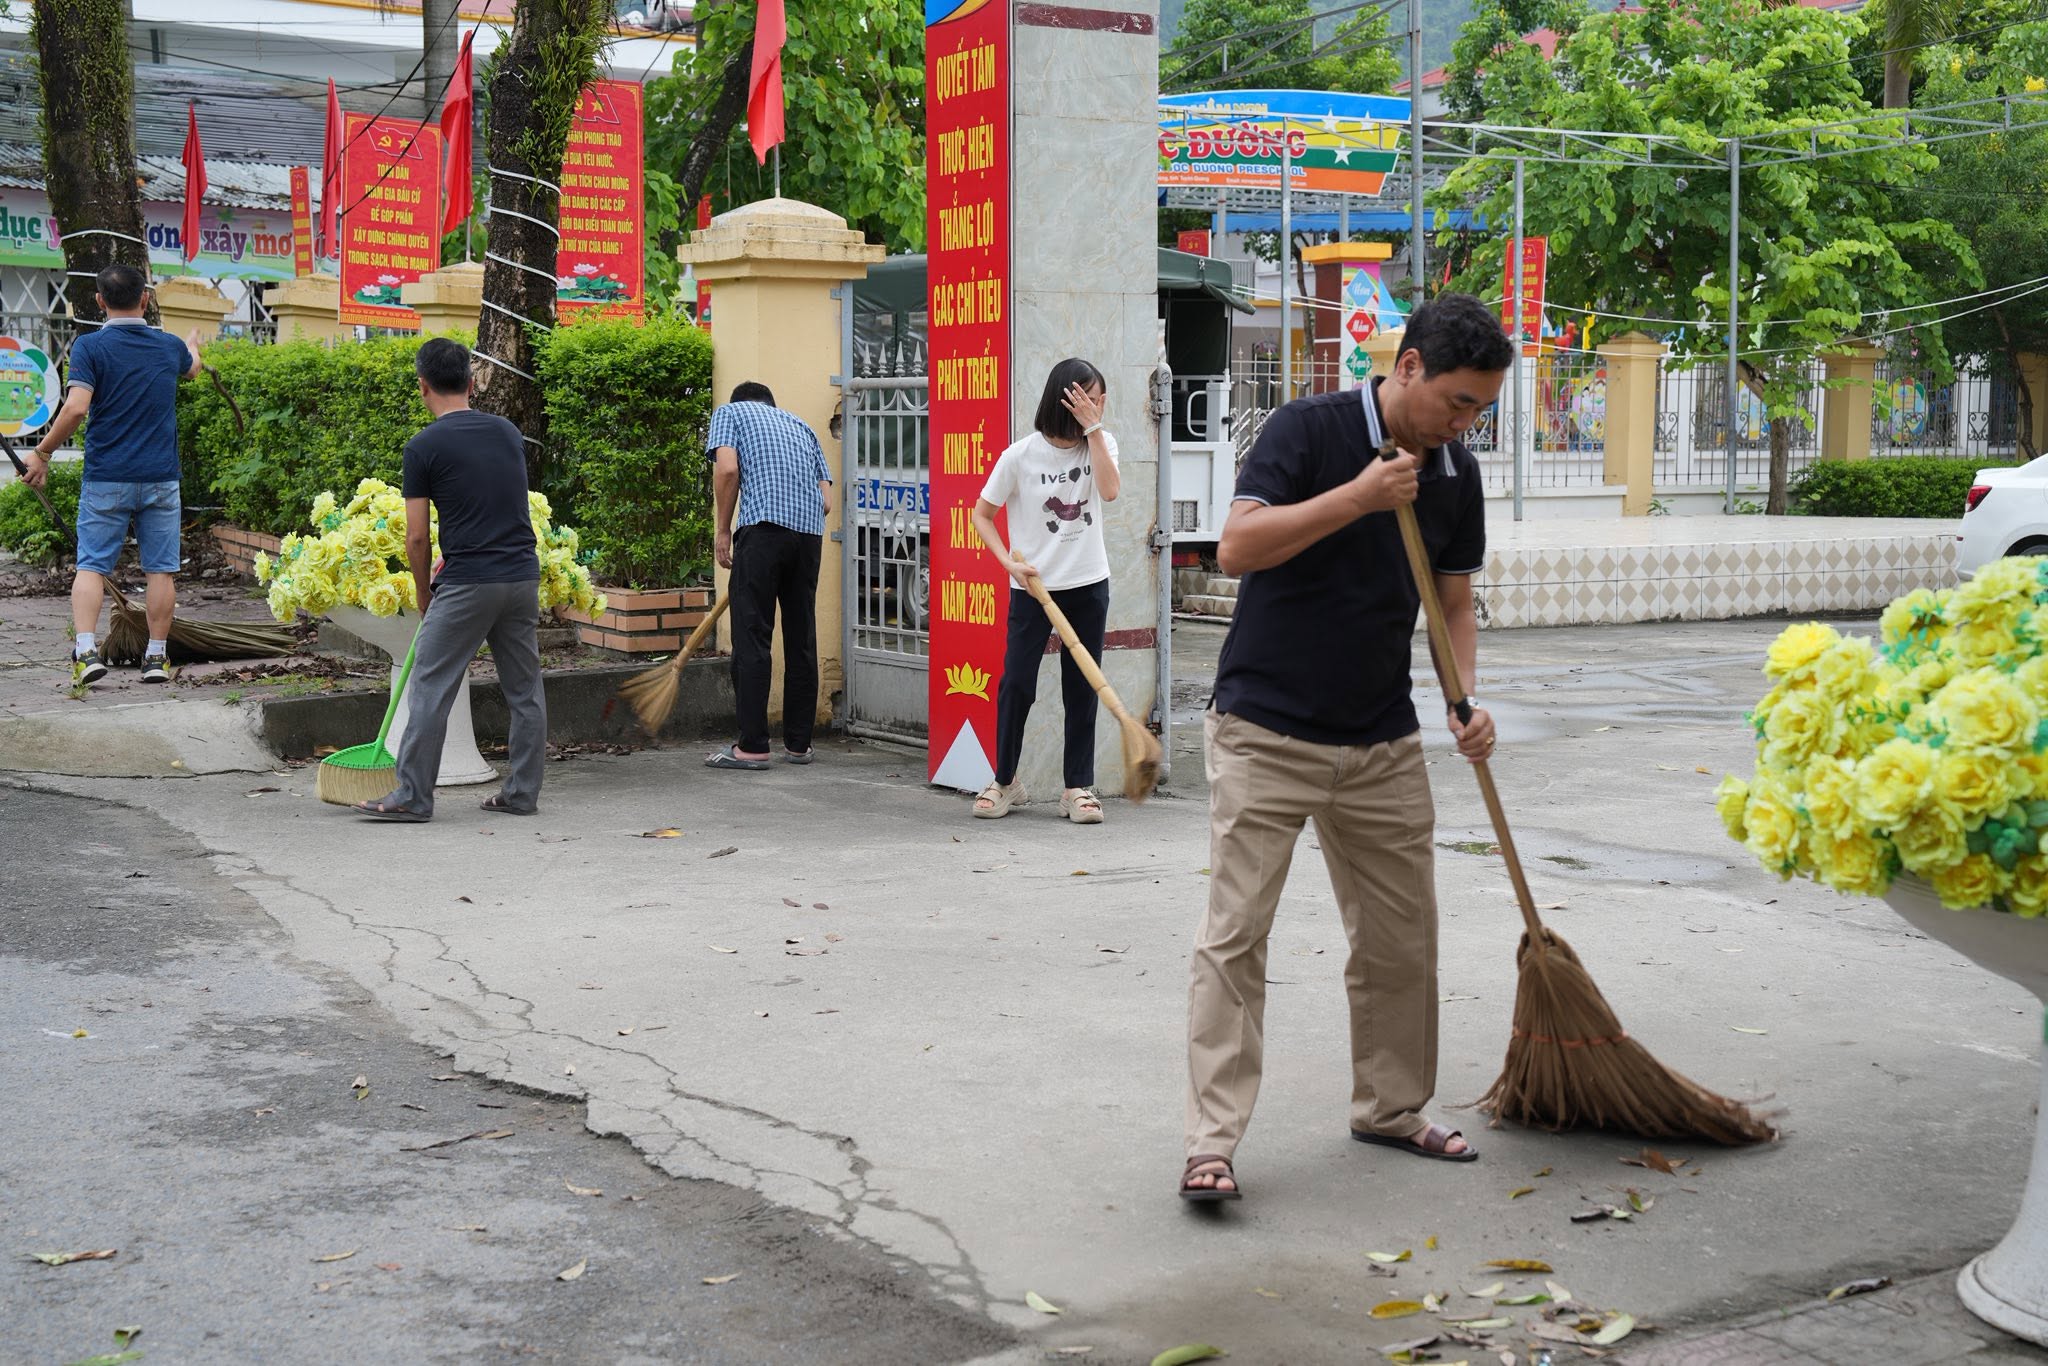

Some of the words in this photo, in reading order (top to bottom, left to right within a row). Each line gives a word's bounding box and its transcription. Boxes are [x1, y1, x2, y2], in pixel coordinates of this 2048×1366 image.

[936, 37, 968, 105] QUYẾT
[972, 37, 996, 92] TÂM
[584, 131, 605, 146] PHONG
[606, 131, 622, 146] TRÀO
[583, 150, 594, 166] YÊU
[938, 125, 965, 183] THỰC
[968, 116, 994, 179] HIỆN
[396, 164, 410, 180] DÂN
[561, 171, 578, 187] HÀNH
[1194, 164, 1233, 174] DUONG
[1239, 165, 1306, 176] PRESCHOL
[384, 186, 396, 200] GIA
[600, 196, 612, 211] CÁC
[381, 206, 394, 223] GÓP
[940, 191, 974, 252] THẮNG
[977, 198, 994, 256] LỢI
[573, 218, 584, 234] ĐẠI
[202, 223, 248, 261] xây
[368, 229, 386, 246] DỰNG
[578, 240, 588, 252] XIV
[348, 250, 370, 266] TRONG
[410, 256, 429, 274] MẠNH
[934, 274, 954, 328] CÁC
[956, 267, 975, 325] CHỈ
[977, 271, 1001, 323] TIÊU
[937, 350, 964, 400] PHÁT
[966, 338, 998, 400] TRIỂN
[944, 433, 968, 475] KINH
[971, 418, 984, 475] TẾ
[906, 486, 929, 510] SÁ
[950, 499, 965, 548] XÃ
[942, 571, 966, 622] NĂM
[968, 582, 995, 626] 2026
